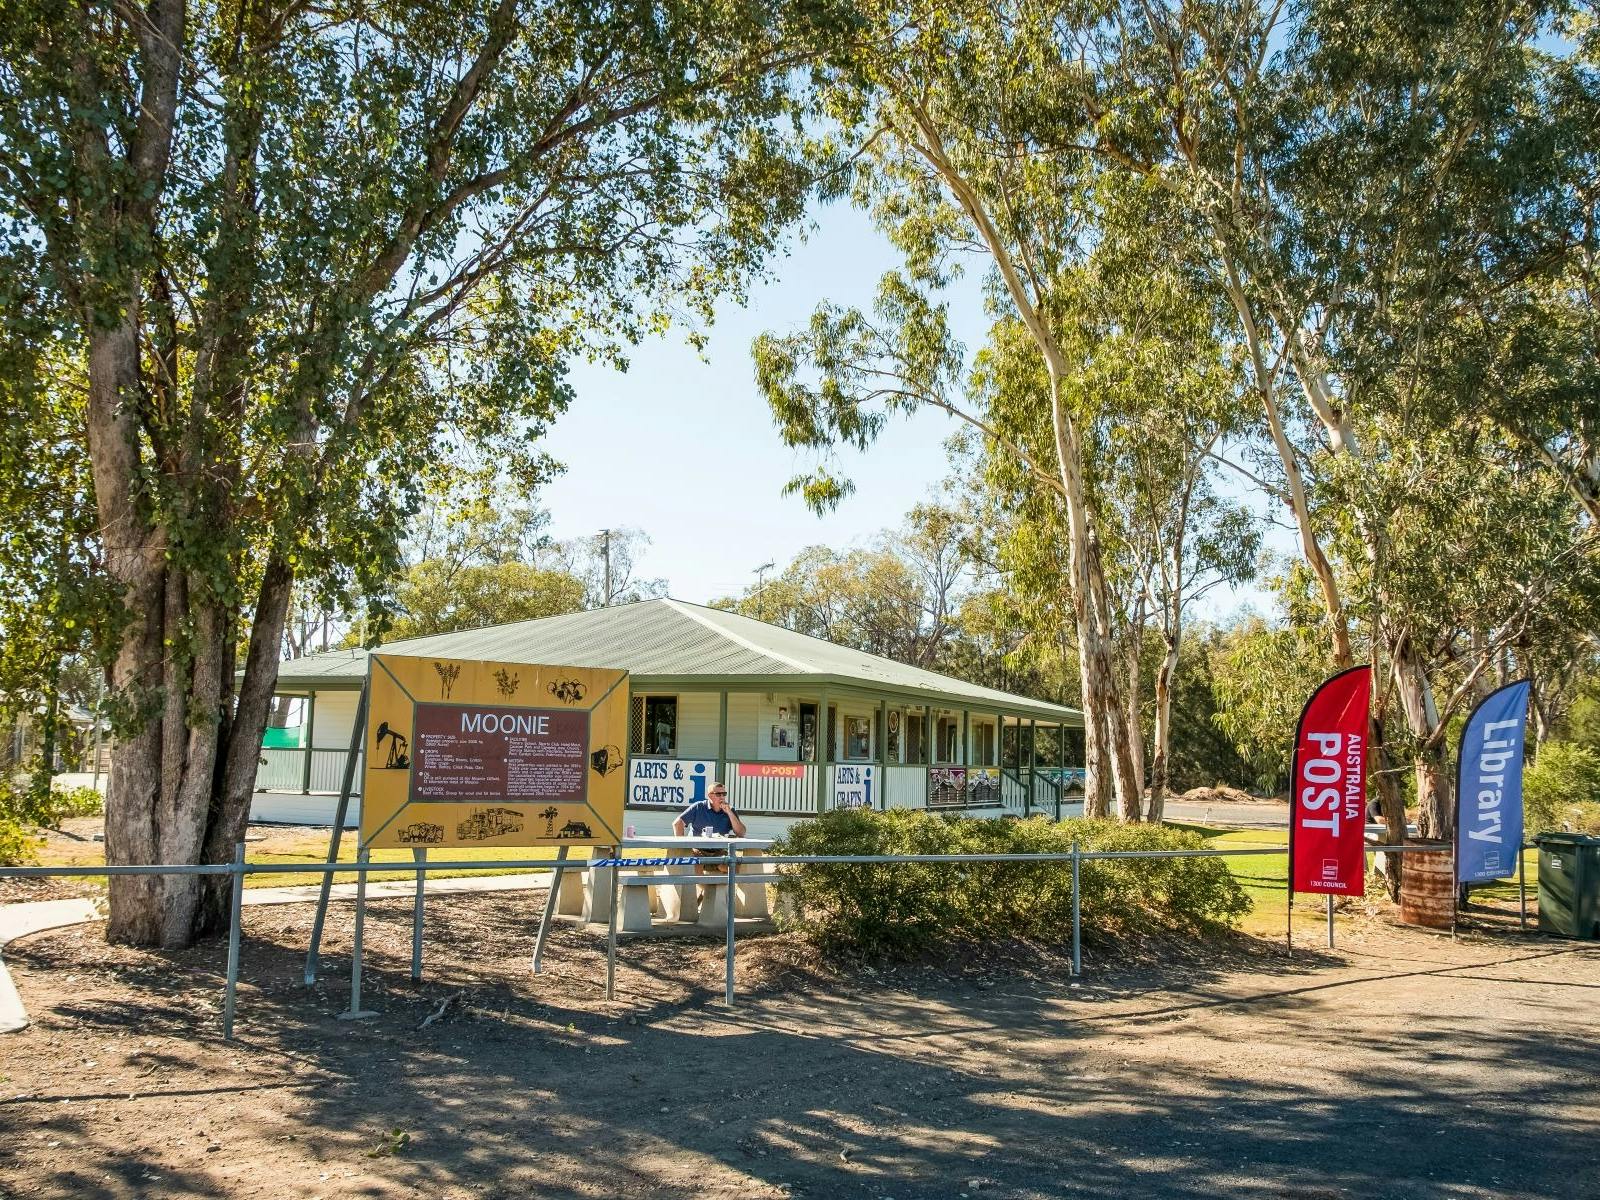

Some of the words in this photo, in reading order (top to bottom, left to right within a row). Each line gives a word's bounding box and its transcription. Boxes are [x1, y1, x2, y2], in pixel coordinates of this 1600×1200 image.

[461, 712, 550, 735] MOONIE
[634, 761, 668, 780] ARTS
[673, 762, 684, 780] &
[771, 766, 797, 776] POST
[837, 767, 854, 785] ARTS
[855, 767, 861, 784] &
[1345, 733, 1361, 820] AUSTRALIA
[1302, 732, 1342, 838] POST
[1468, 718, 1519, 844] Library
[633, 784, 684, 804] CRAFTS
[836, 791, 862, 808] CRAFTS
[1322, 881, 1348, 889] COUNCIL
